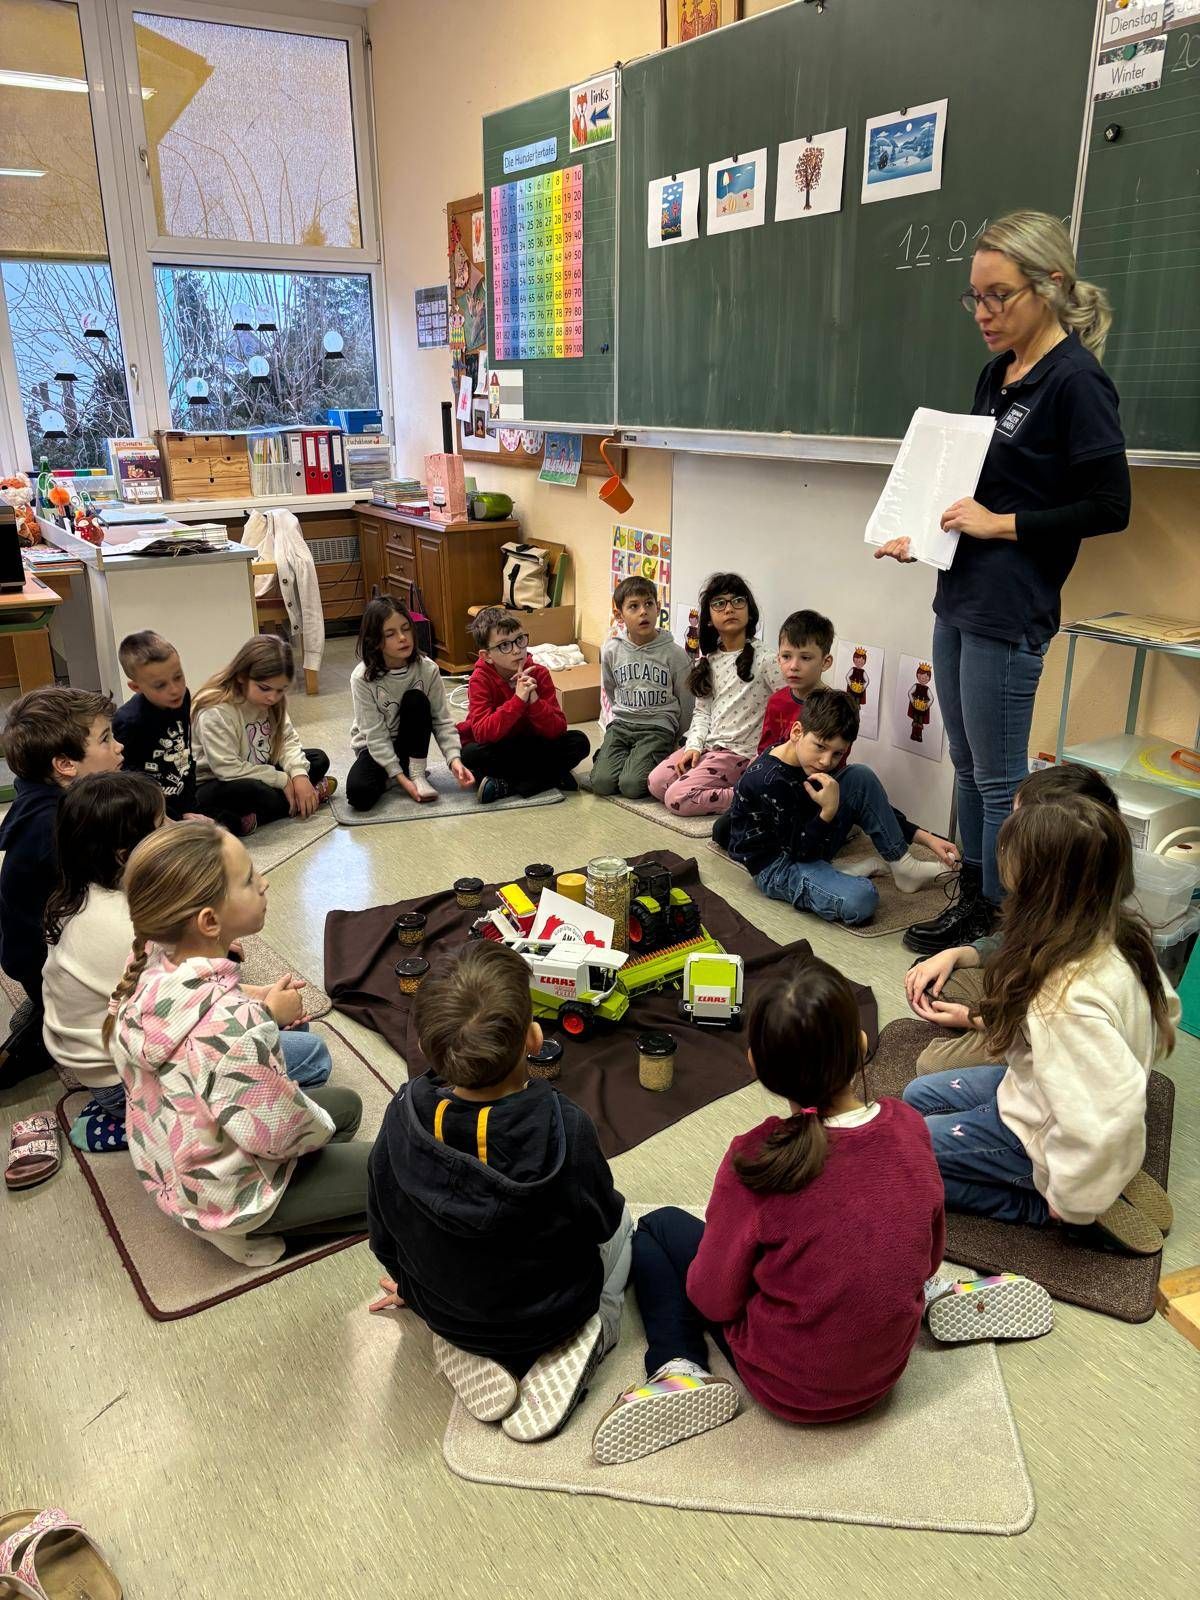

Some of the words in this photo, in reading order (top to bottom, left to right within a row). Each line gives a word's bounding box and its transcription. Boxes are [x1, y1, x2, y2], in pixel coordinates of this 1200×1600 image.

[1110, 8, 1158, 34] Dienstag
[1112, 64, 1146, 84] Winter
[590, 88, 609, 105] links
[504, 158, 514, 168] Die
[660, 560, 670, 584] H
[660, 609, 668, 627] P
[614, 662, 668, 687] CHICAGO
[620, 690, 667, 707] ILLINOIS
[540, 976, 575, 986] CLAAS
